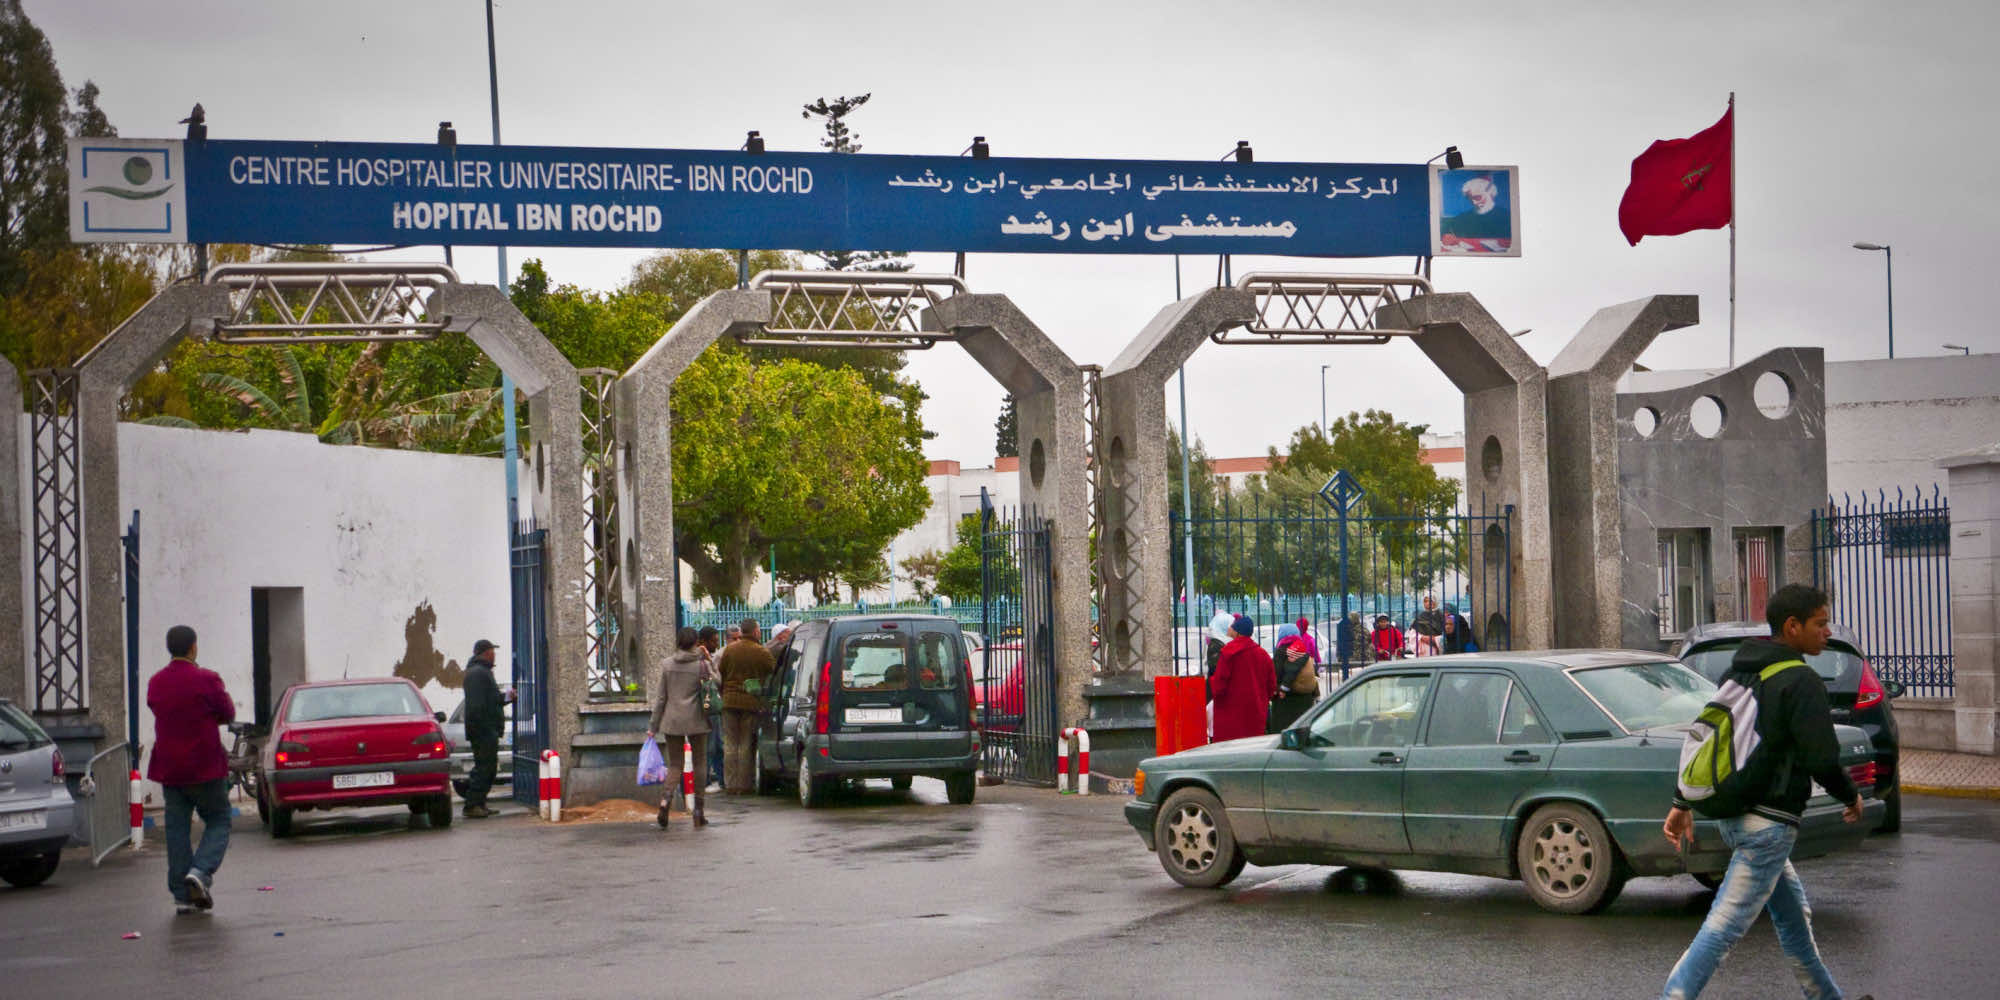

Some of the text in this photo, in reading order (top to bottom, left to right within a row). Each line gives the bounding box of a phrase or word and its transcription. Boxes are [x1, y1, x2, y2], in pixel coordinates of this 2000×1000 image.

[230, 156, 330, 185] CENTRE
[338, 158, 493, 189] HOSPITALIER
[688, 165, 725, 192] IBN
[732, 165, 814, 194] ROCHD
[888, 168, 954, 194] رشد
[1142, 173, 1318, 201] الاستشفائي
[1325, 176, 1398, 200] المركز
[393, 201, 662, 233] HOPITAL IBN ROCHD
[1000, 210, 1298, 242] مستشفى ابن رشد
